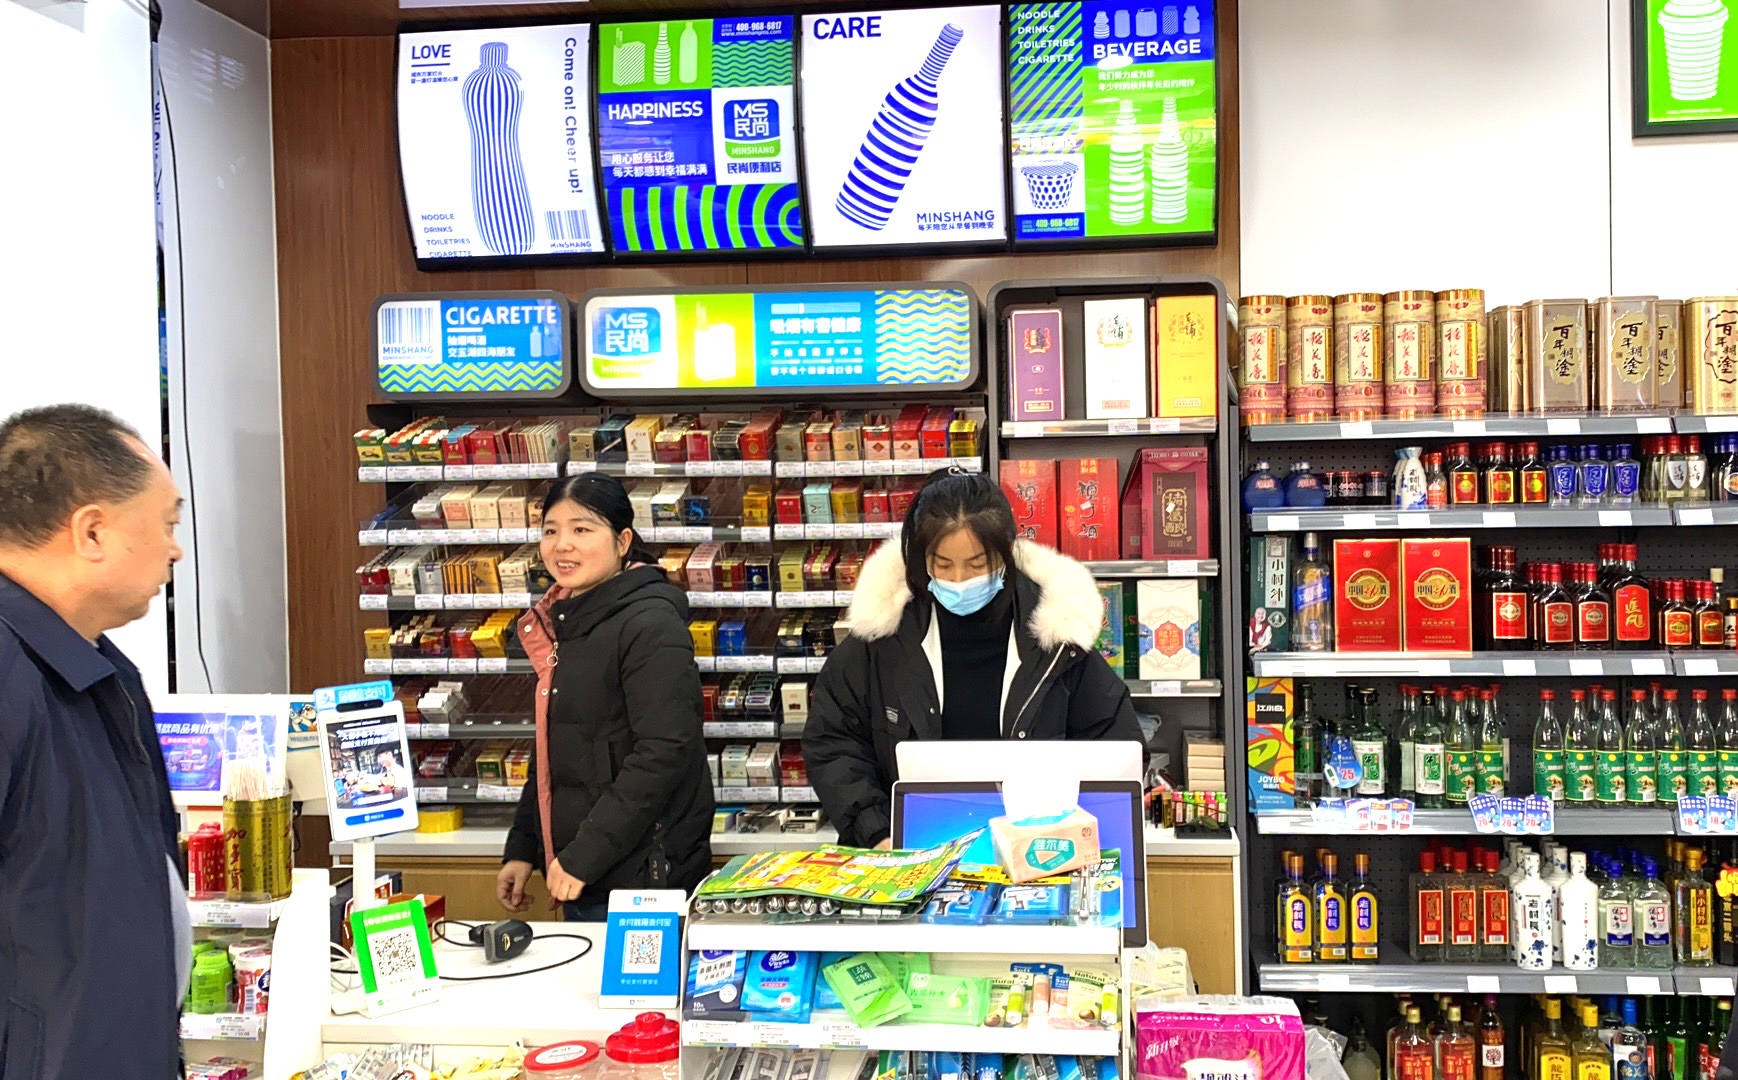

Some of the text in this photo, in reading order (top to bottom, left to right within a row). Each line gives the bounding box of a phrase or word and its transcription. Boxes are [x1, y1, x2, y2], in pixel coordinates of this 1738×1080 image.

[1017, 10, 1060, 20] NOODLE
[813, 16, 882, 40] CARE
[1018, 25, 1055, 34] DRINKS
[1018, 39, 1075, 49] TOILETRIES
[1093, 39, 1201, 59] BEVERAGE
[411, 44, 451, 59] LOVE
[1018, 54, 1074, 64] CIGARETTE
[564, 37, 583, 193] Come on! Cheer up!
[608, 101, 703, 120] HAPPINESS
[734, 103, 768, 118] MS
[735, 118, 769, 137] 民尚
[732, 146, 775, 155] MINSHANG
[612, 152, 675, 165] 用心服务让您
[613, 164, 708, 179] 每天都感到幸福满满
[727, 161, 782, 174] 民尚便利店
[421, 213, 455, 221] NOODLE
[916, 210, 995, 223] MINSHANG
[426, 238, 471, 246] TOILETRIES
[550, 241, 592, 249] MINSHANG
[429, 250, 472, 258] CIGARETTE
[445, 306, 557, 325] CIGARETTE
[605, 313, 648, 329] MS
[605, 330, 649, 352] 民尚
[383, 346, 434, 354] MINSHANG
[1341, 768, 1354, 780] 25
[1684, 818, 1693, 826] 18
[1711, 816, 1719, 825] 18
[1074, 971, 1105, 982] Natural
